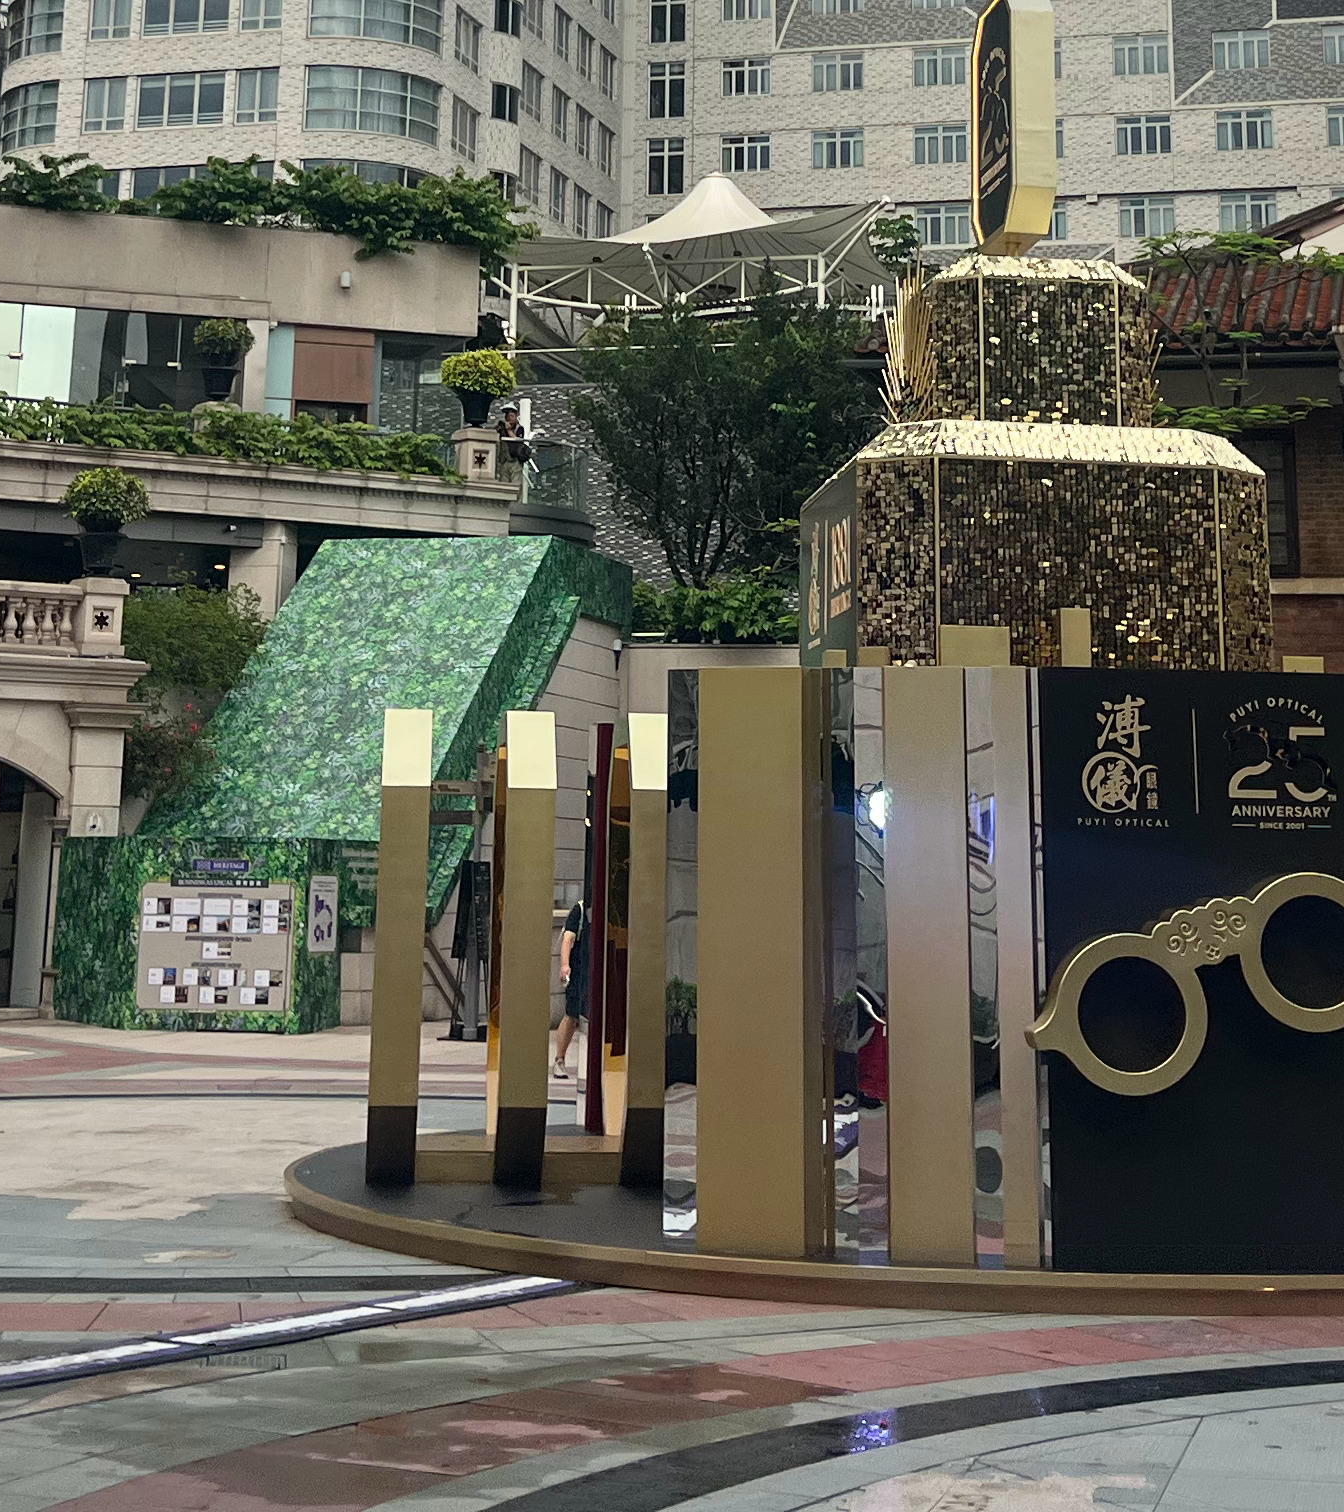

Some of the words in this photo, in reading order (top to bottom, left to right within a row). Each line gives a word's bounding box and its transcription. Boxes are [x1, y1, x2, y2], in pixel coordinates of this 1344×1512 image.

[1229, 699, 1260, 723] PUYI
[1266, 697, 1324, 725] OPTICAL
[1231, 804, 1331, 819] ANNIVERSARY
[1077, 817, 1107, 826] PUYI
[1114, 817, 1170, 828] OPTICAL
[1259, 821, 1285, 830] SINCE
[1285, 821, 1305, 830] 2001
